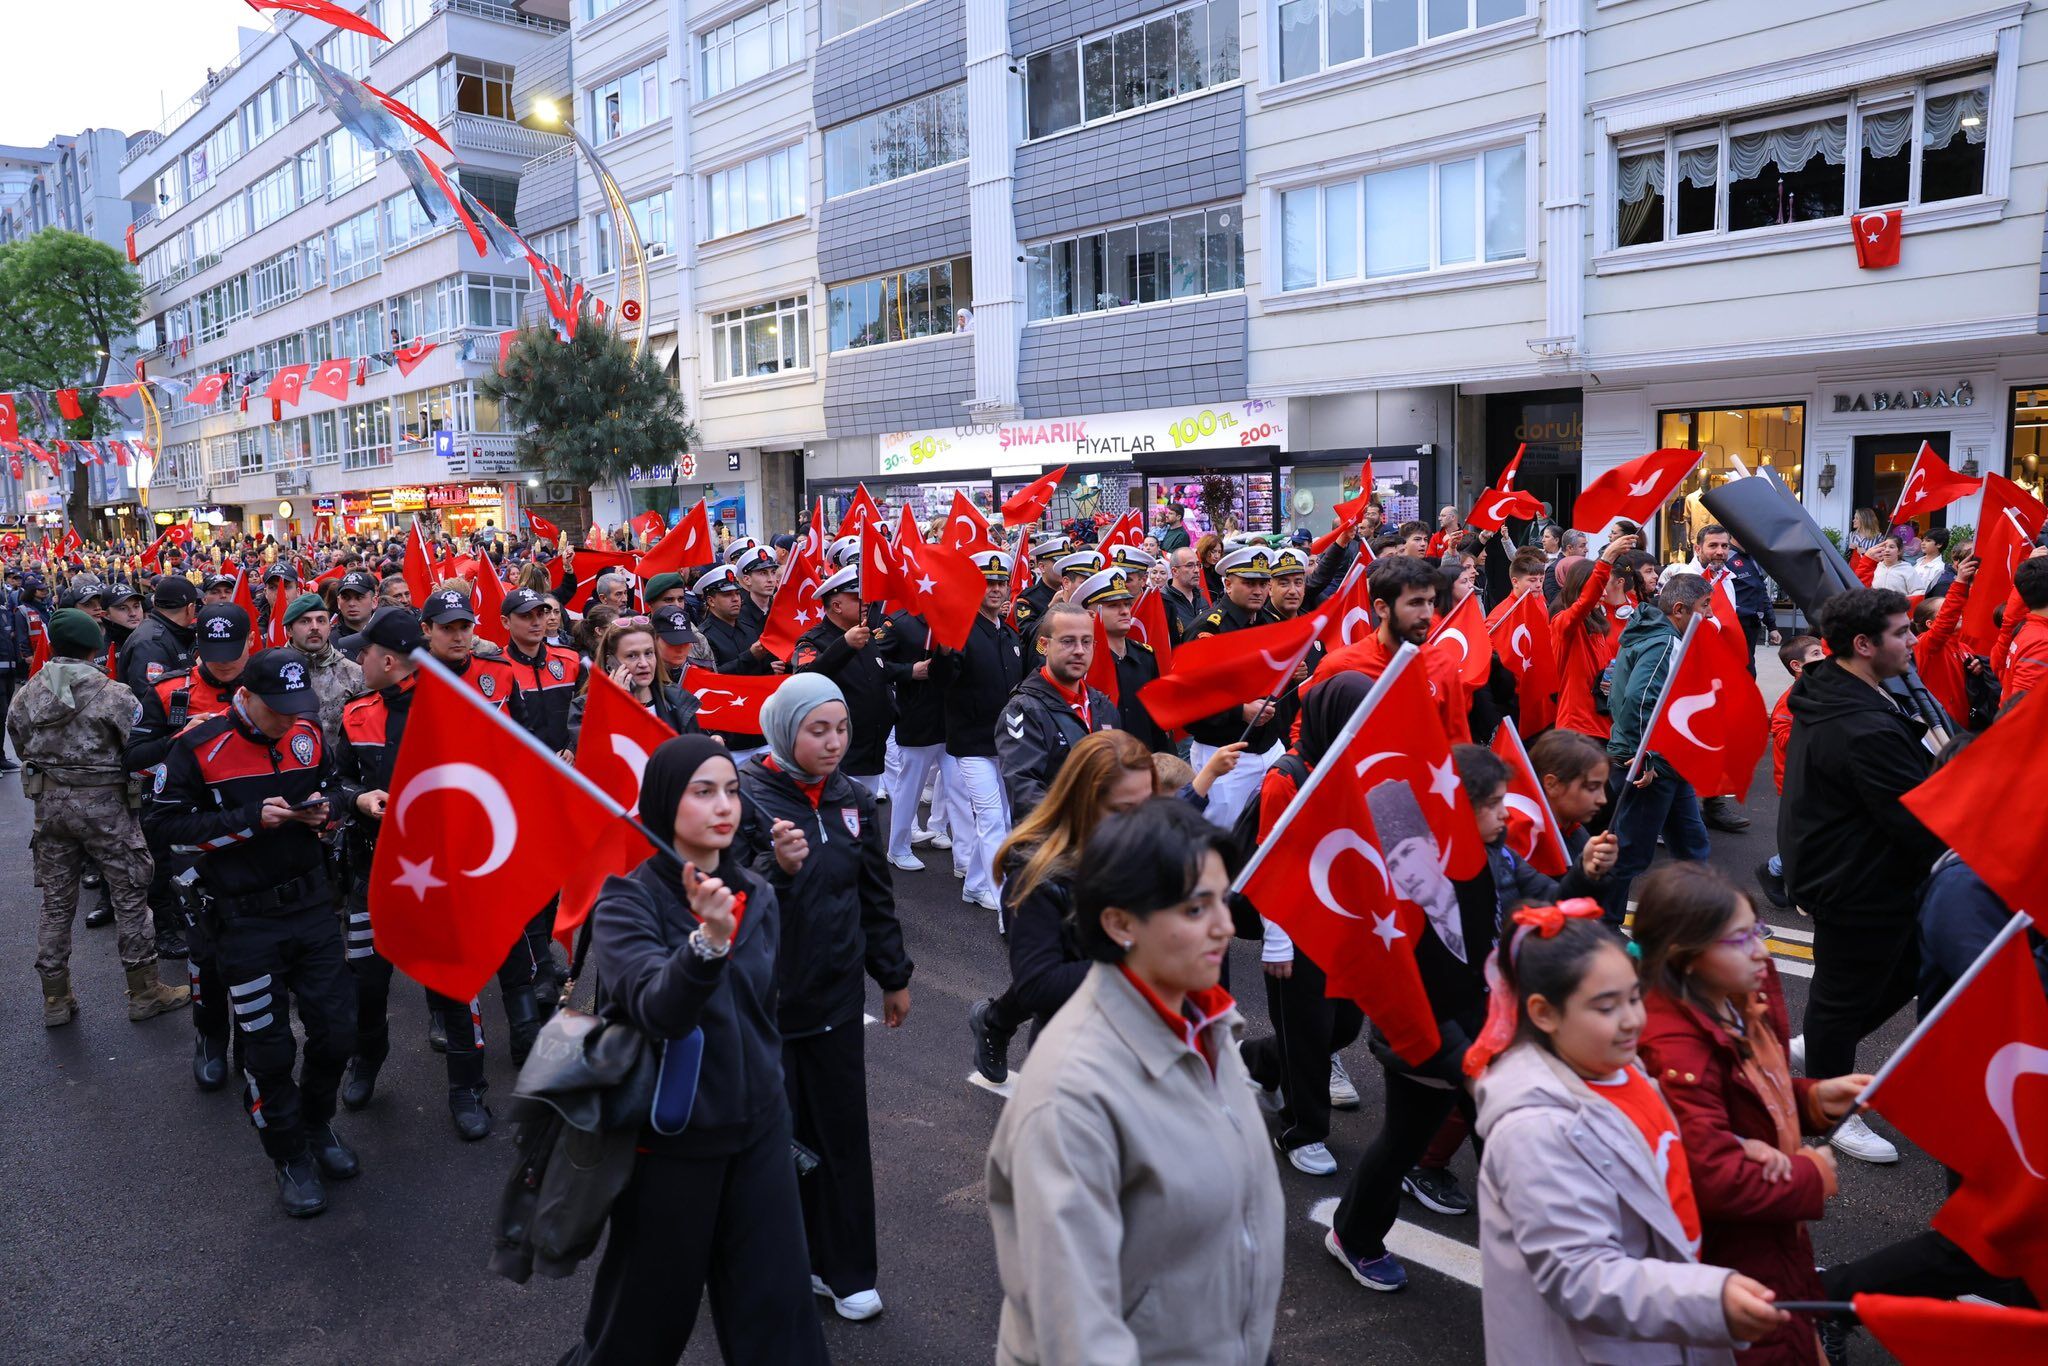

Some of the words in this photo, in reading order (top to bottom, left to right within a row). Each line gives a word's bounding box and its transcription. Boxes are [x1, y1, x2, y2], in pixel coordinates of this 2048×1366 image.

[1833, 380, 1974, 412] BABADAĞ
[1243, 400, 1263, 416] 75
[999, 422, 1087, 452] ŞIMARIK
[1168, 410, 1217, 448] 100
[1218, 412, 1238, 430] TL
[1240, 423, 1271, 446] 200
[909, 436, 936, 465] 50
[937, 438, 951, 452] TL
[1076, 434, 1155, 454] FİYATLAR
[728, 456, 738, 464] 24
[884, 454, 899, 471] 30
